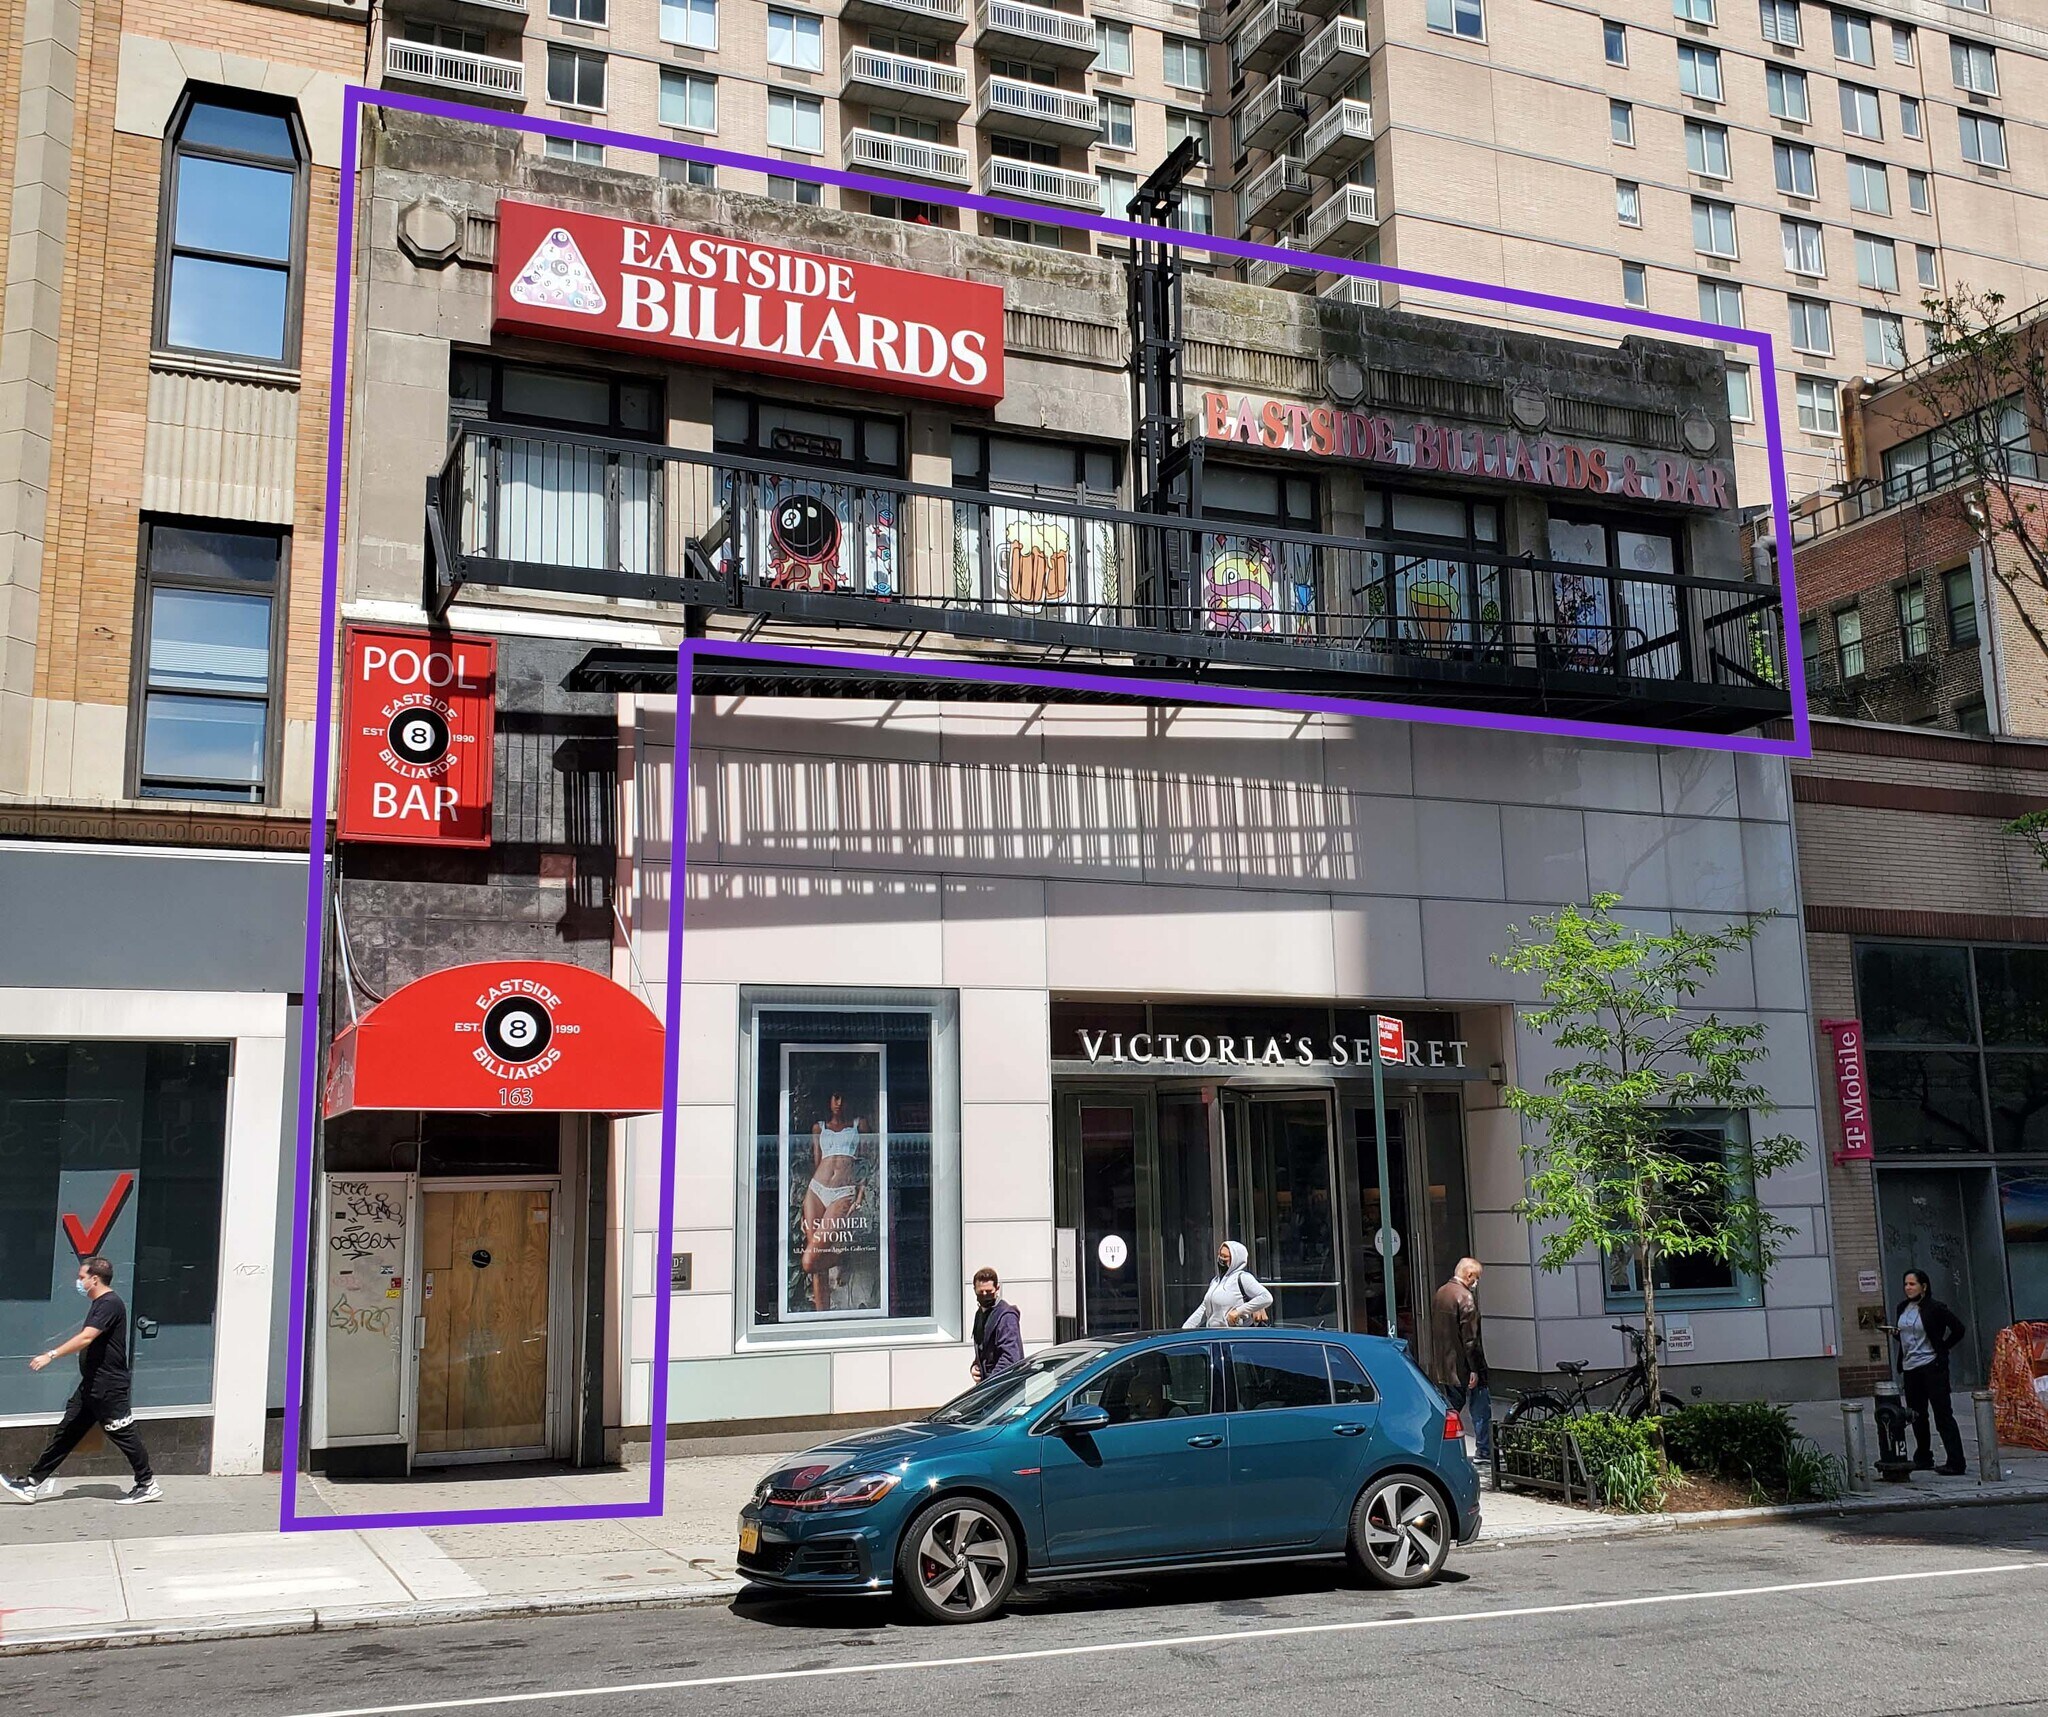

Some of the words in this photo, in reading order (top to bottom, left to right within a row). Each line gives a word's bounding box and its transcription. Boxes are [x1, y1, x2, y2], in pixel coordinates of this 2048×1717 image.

[620, 226, 856, 303] EASTSIDE
[617, 272, 988, 386] BILLIARDS
[774, 433, 841, 458] OPEN
[1205, 391, 1398, 465] EASTSIDE
[1411, 423, 1609, 495] BILLIARDS
[1622, 455, 1643, 498] &
[1657, 458, 1730, 508] BAR
[363, 646, 477, 689] POOL
[381, 693, 458, 722] EASTSIDE
[411, 728, 427, 744] 8
[452, 735, 475, 743] 1990
[378, 749, 458, 779] BILLIARDS
[372, 782, 459, 822] BAR
[475, 979, 562, 1010] EASTSIDE
[454, 1023, 481, 1032] EST.
[509, 1020, 527, 1038] 8
[555, 1025, 580, 1033] 1990
[472, 1046, 562, 1080] BILLIARDS
[1078, 1029, 1314, 1068] VICTORIA'S
[1330, 1034, 1468, 1068] SERET
[499, 1088, 533, 1105] 163
[813, 1217, 868, 1229] SUMMER
[813, 1231, 855, 1242] STORY
